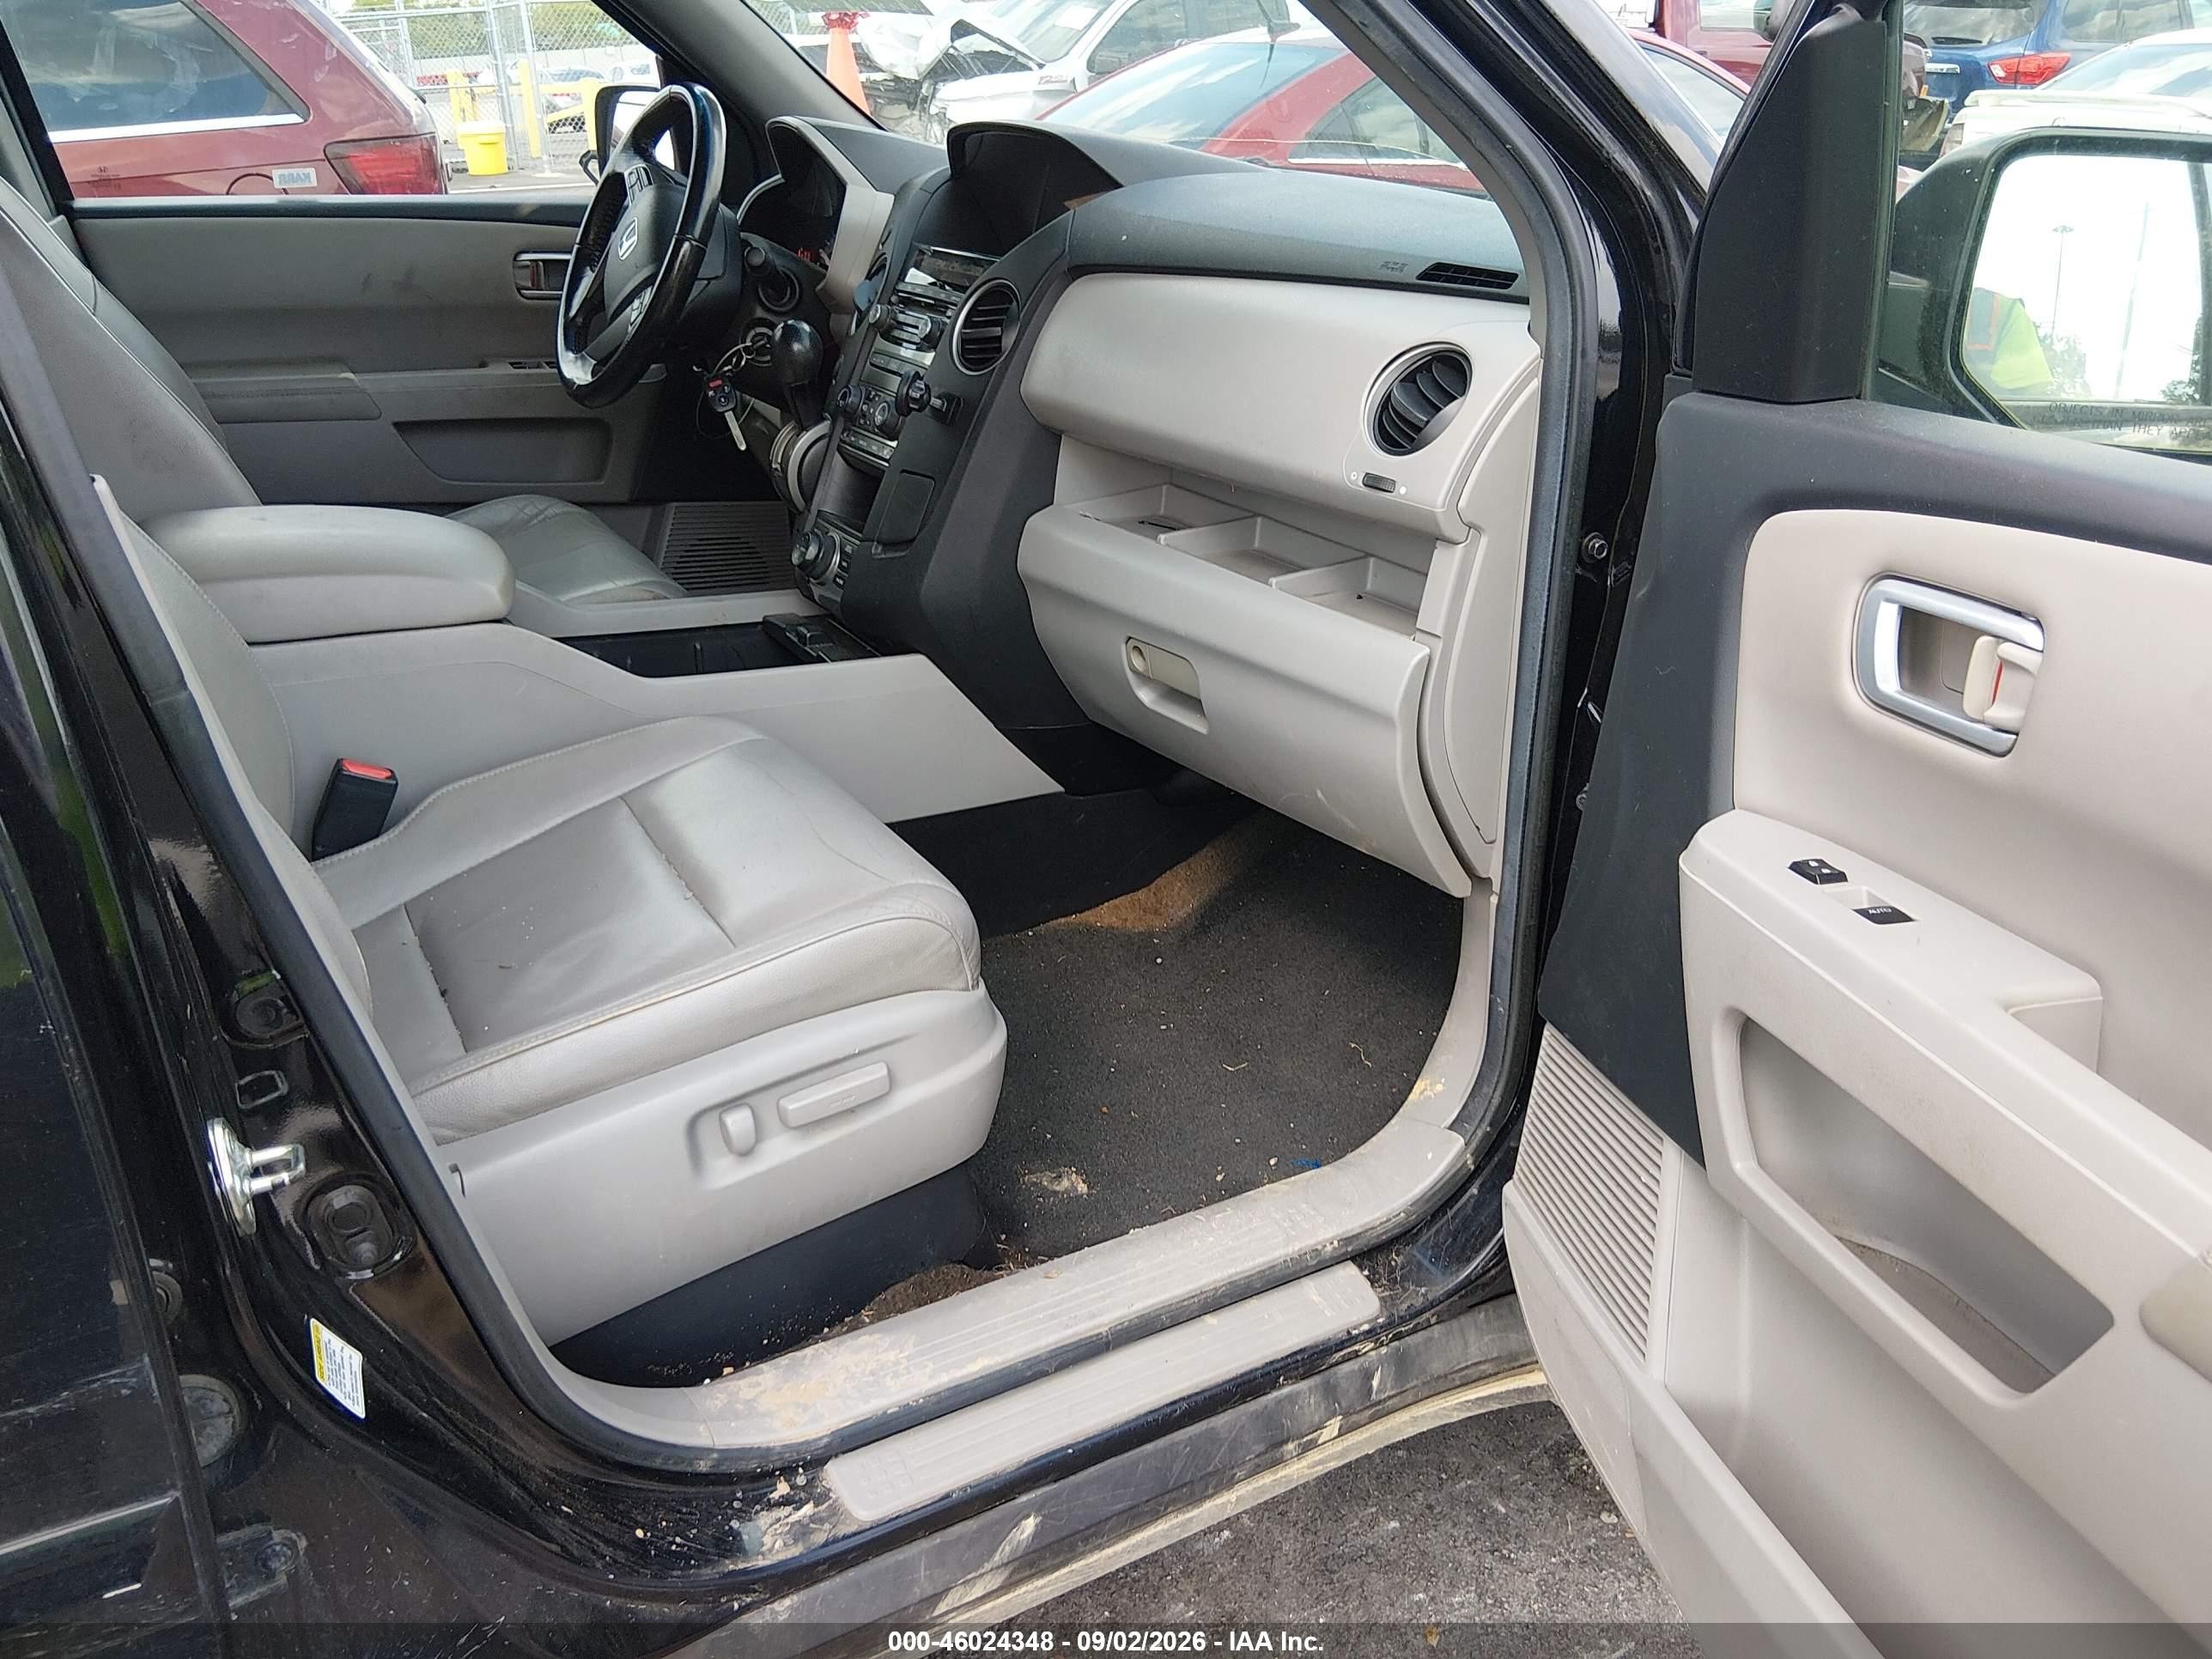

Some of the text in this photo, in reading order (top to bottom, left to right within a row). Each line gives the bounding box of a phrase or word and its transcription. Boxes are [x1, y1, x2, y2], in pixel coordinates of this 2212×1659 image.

[2048, 401, 2103, 416] OBJECTS
[2109, 408, 2124, 418] IN
[2132, 410, 2180, 424] MIRROR
[2133, 418, 2164, 436] THEY
